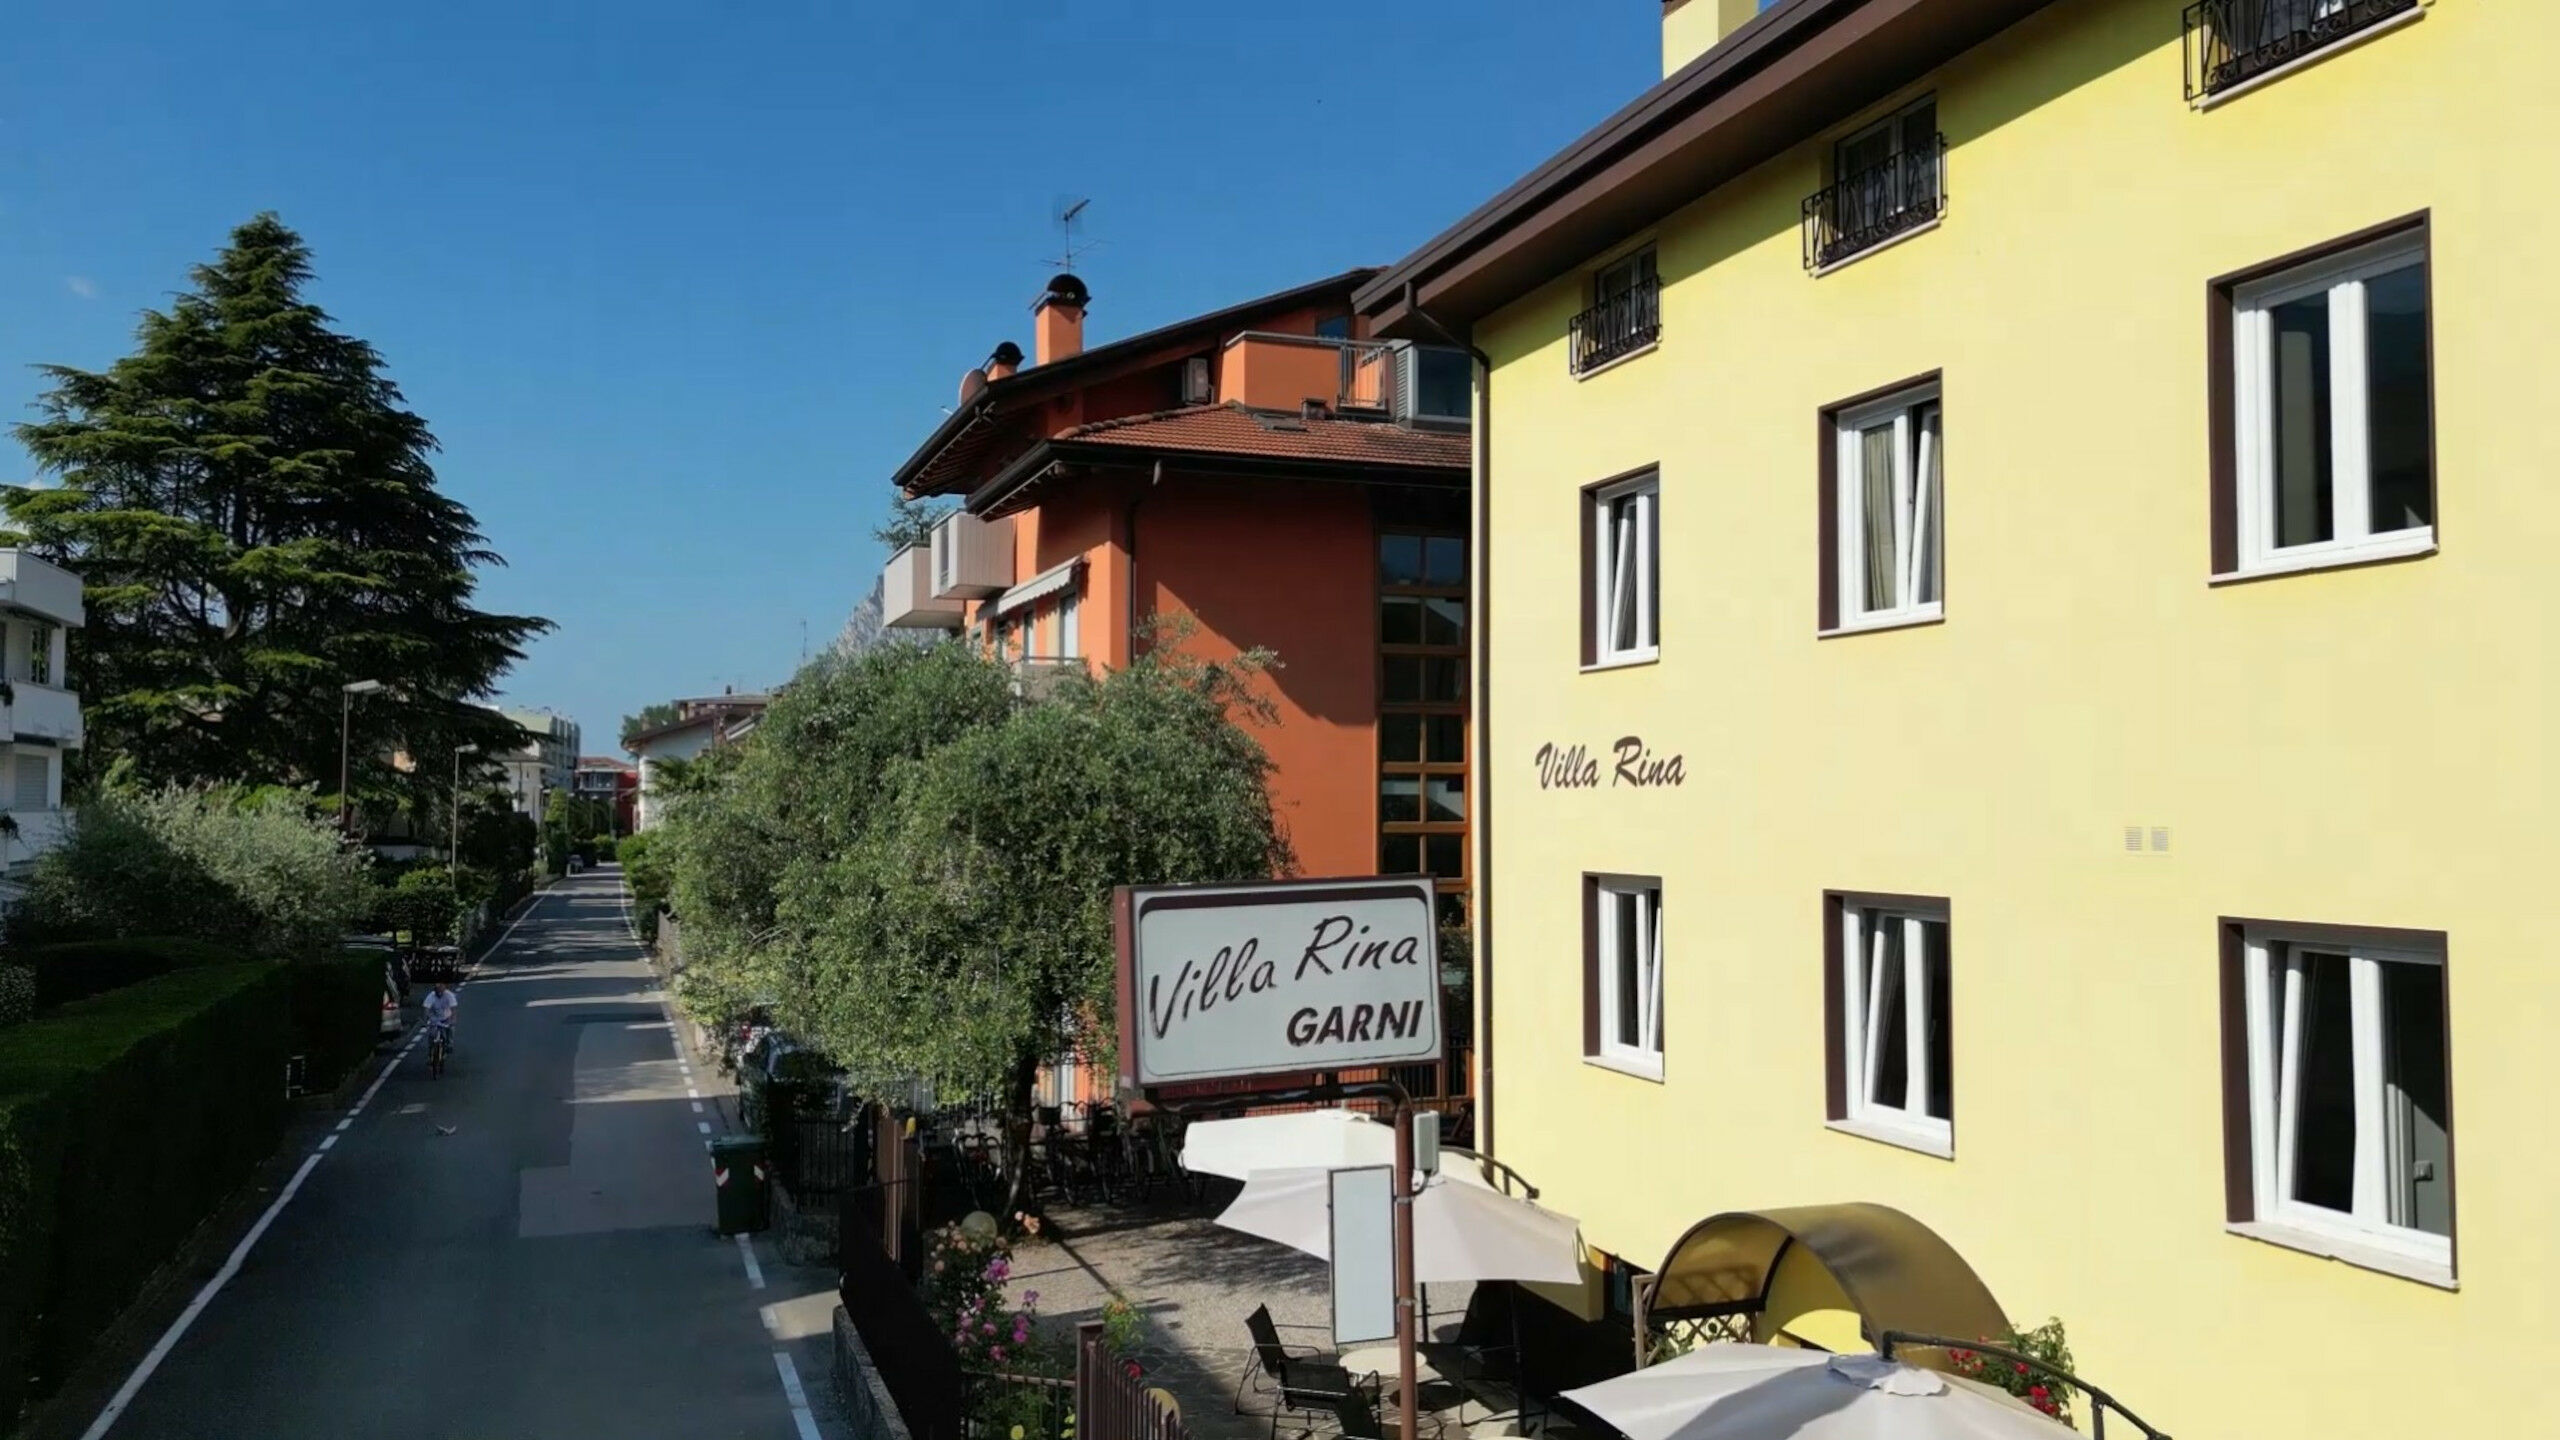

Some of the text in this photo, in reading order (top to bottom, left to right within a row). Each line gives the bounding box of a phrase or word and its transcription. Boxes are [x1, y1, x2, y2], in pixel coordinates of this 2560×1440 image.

[1535, 736, 1686, 790] Villa Rina
[1150, 915, 1418, 1039] Villa Rina
[1287, 1000, 1424, 1047] GARNI
